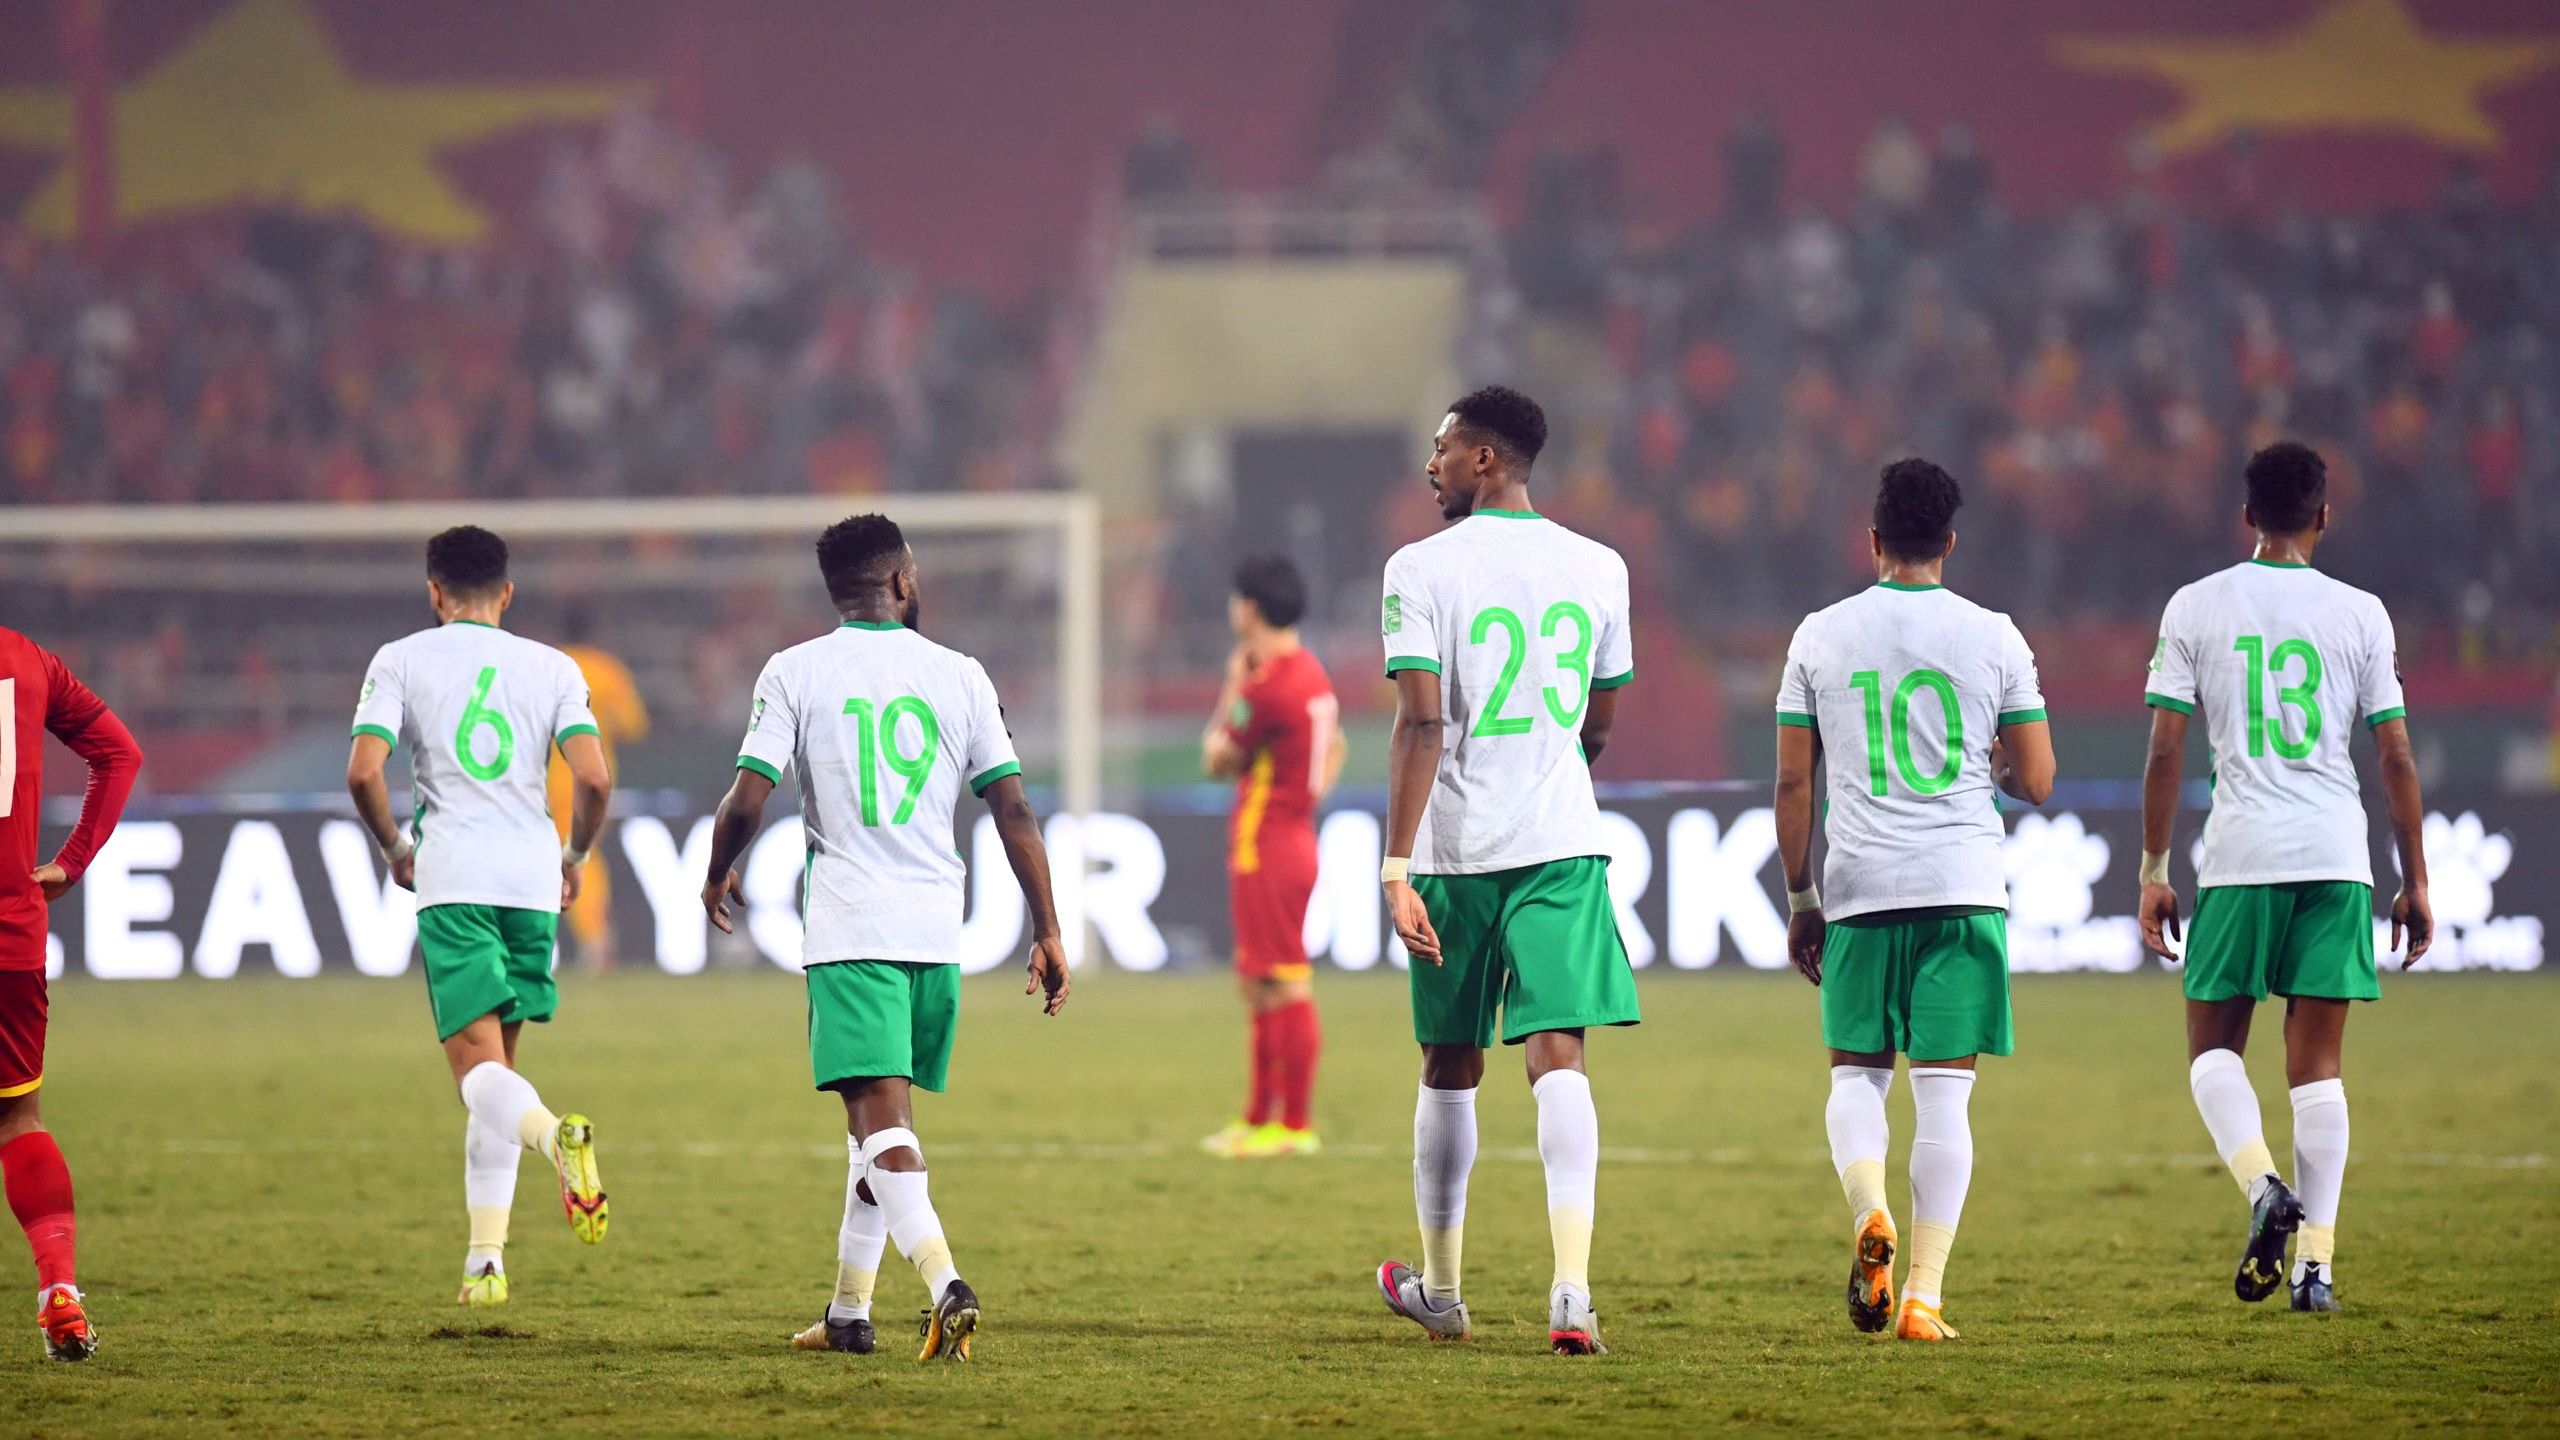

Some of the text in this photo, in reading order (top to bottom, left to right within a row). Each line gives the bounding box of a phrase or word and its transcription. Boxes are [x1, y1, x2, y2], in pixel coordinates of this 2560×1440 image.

[456, 667, 513, 781] 6
[1470, 602, 1592, 736] 23
[1851, 670, 1962, 795] 10
[2235, 636, 2321, 759] 13
[844, 696, 938, 825] 19
[46, 819, 560, 979] EAV
[1302, 807, 1789, 970] MRK
